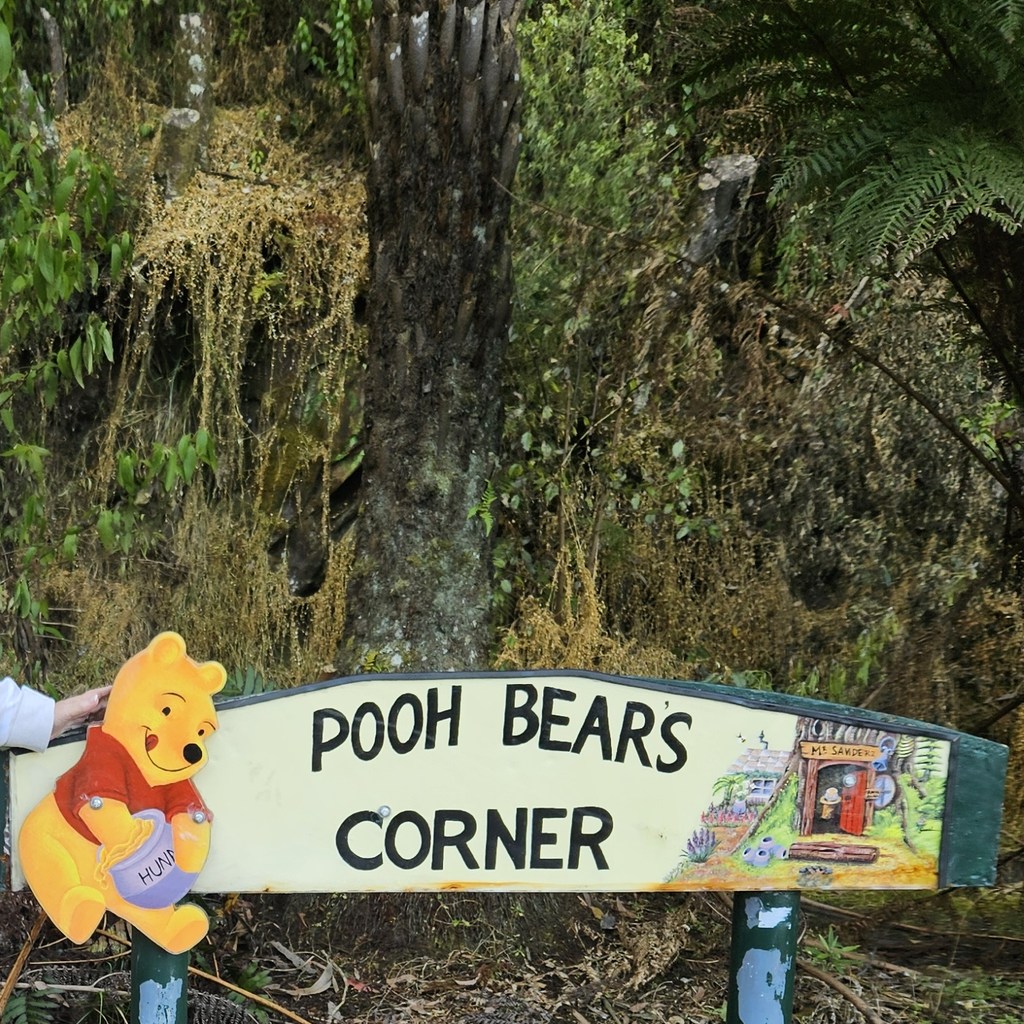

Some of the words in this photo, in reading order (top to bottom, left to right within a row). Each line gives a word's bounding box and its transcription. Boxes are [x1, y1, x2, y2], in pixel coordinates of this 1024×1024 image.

[312, 685, 462, 772] POOH
[502, 684, 693, 774] BEAR'S
[335, 806, 614, 870] CORNER
